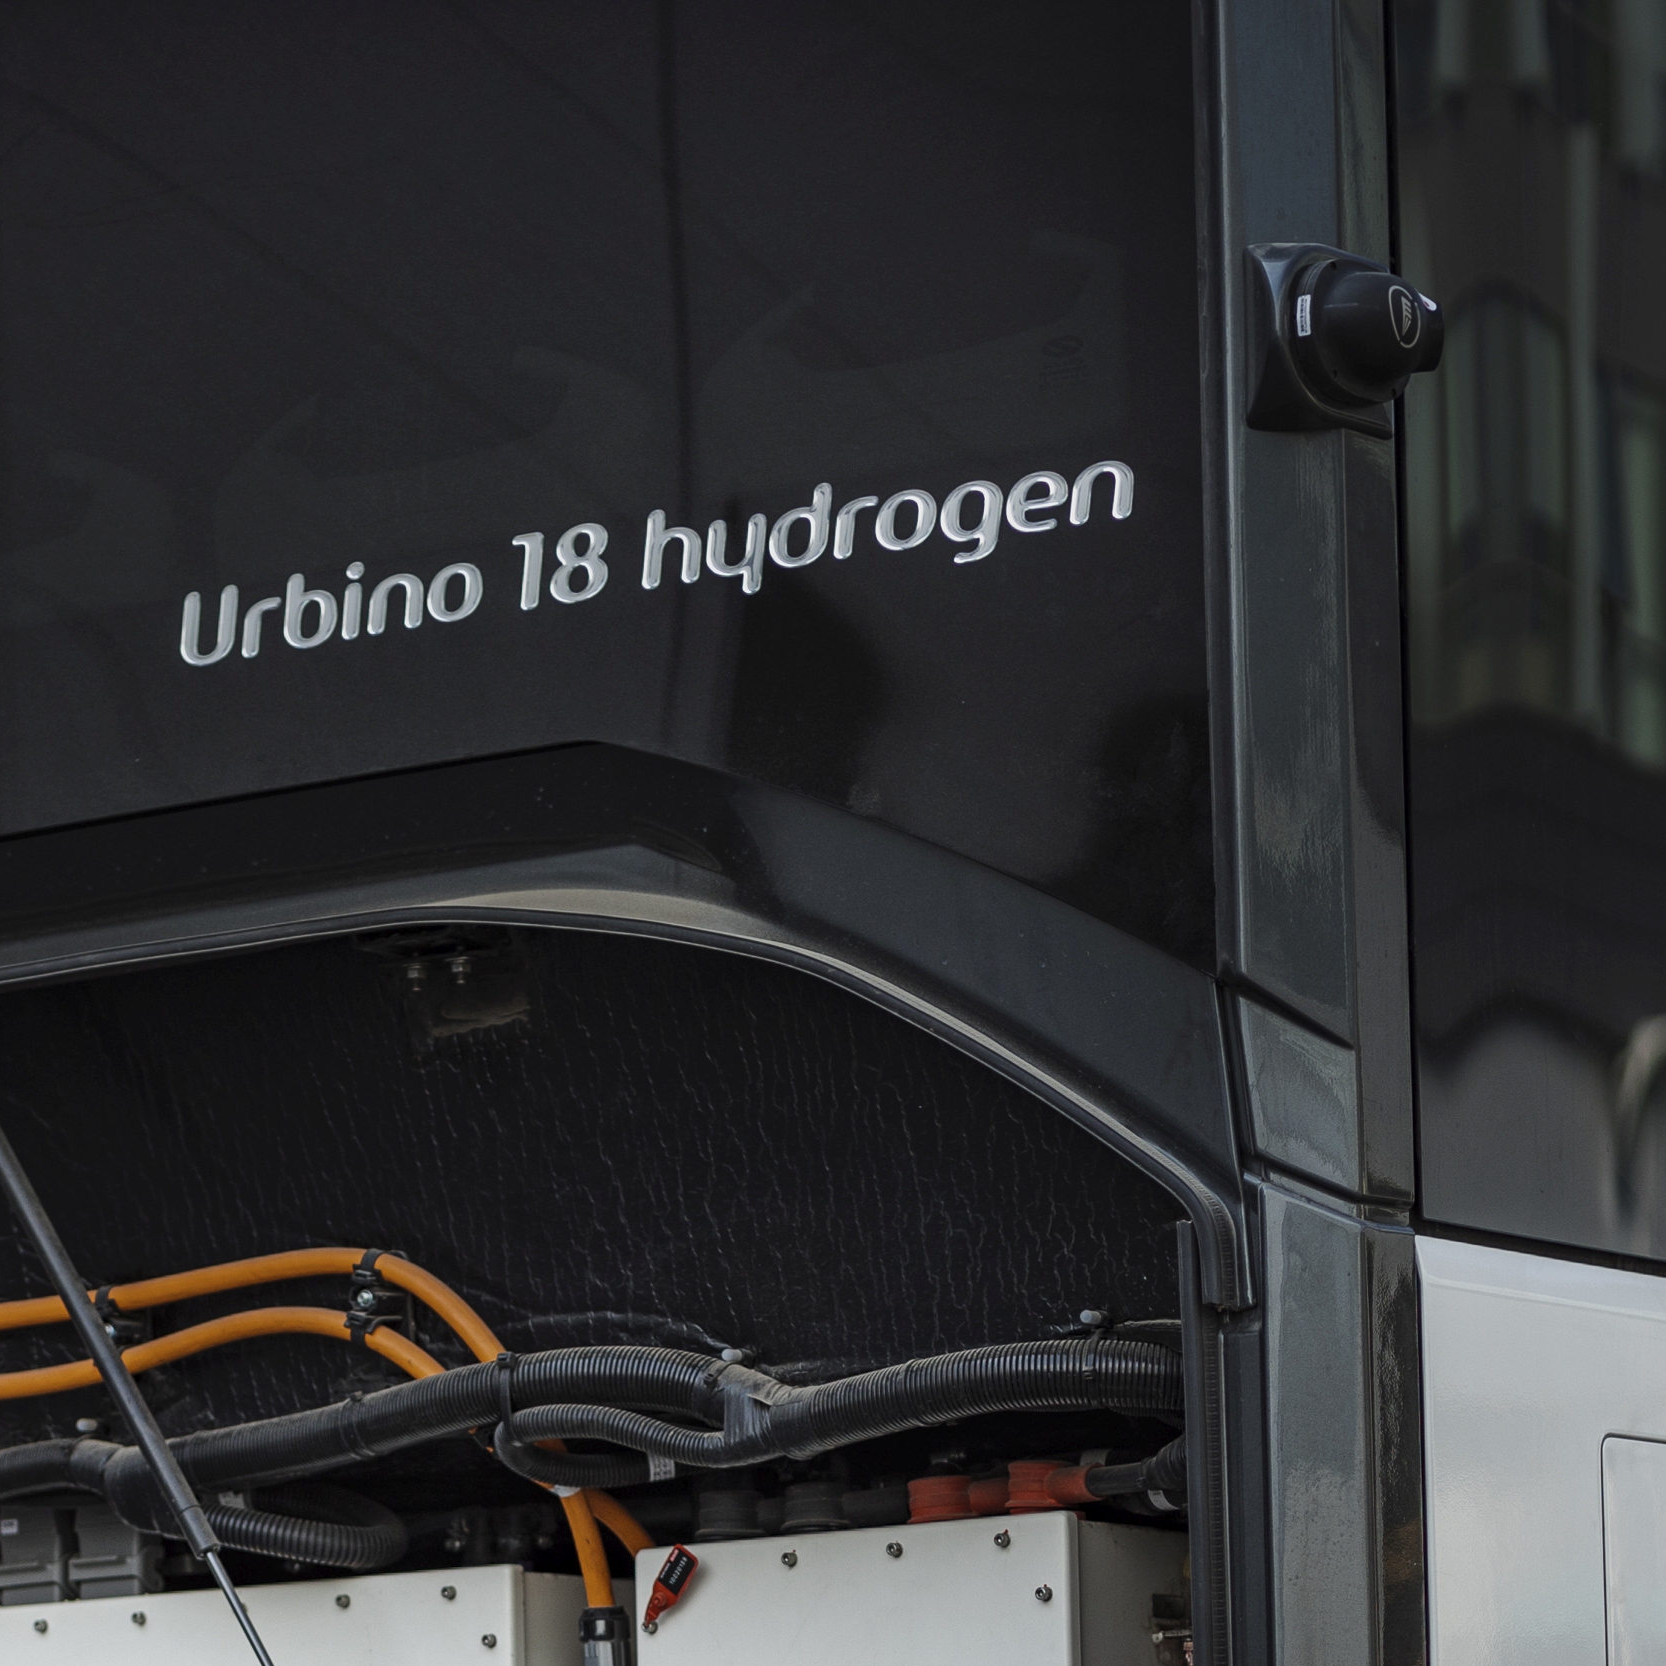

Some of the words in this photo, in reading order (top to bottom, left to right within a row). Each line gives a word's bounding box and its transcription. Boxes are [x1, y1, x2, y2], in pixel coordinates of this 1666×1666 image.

[178, 560, 484, 667] Urbino
[511, 522, 609, 611] 18
[639, 459, 1135, 596] hydrogen
